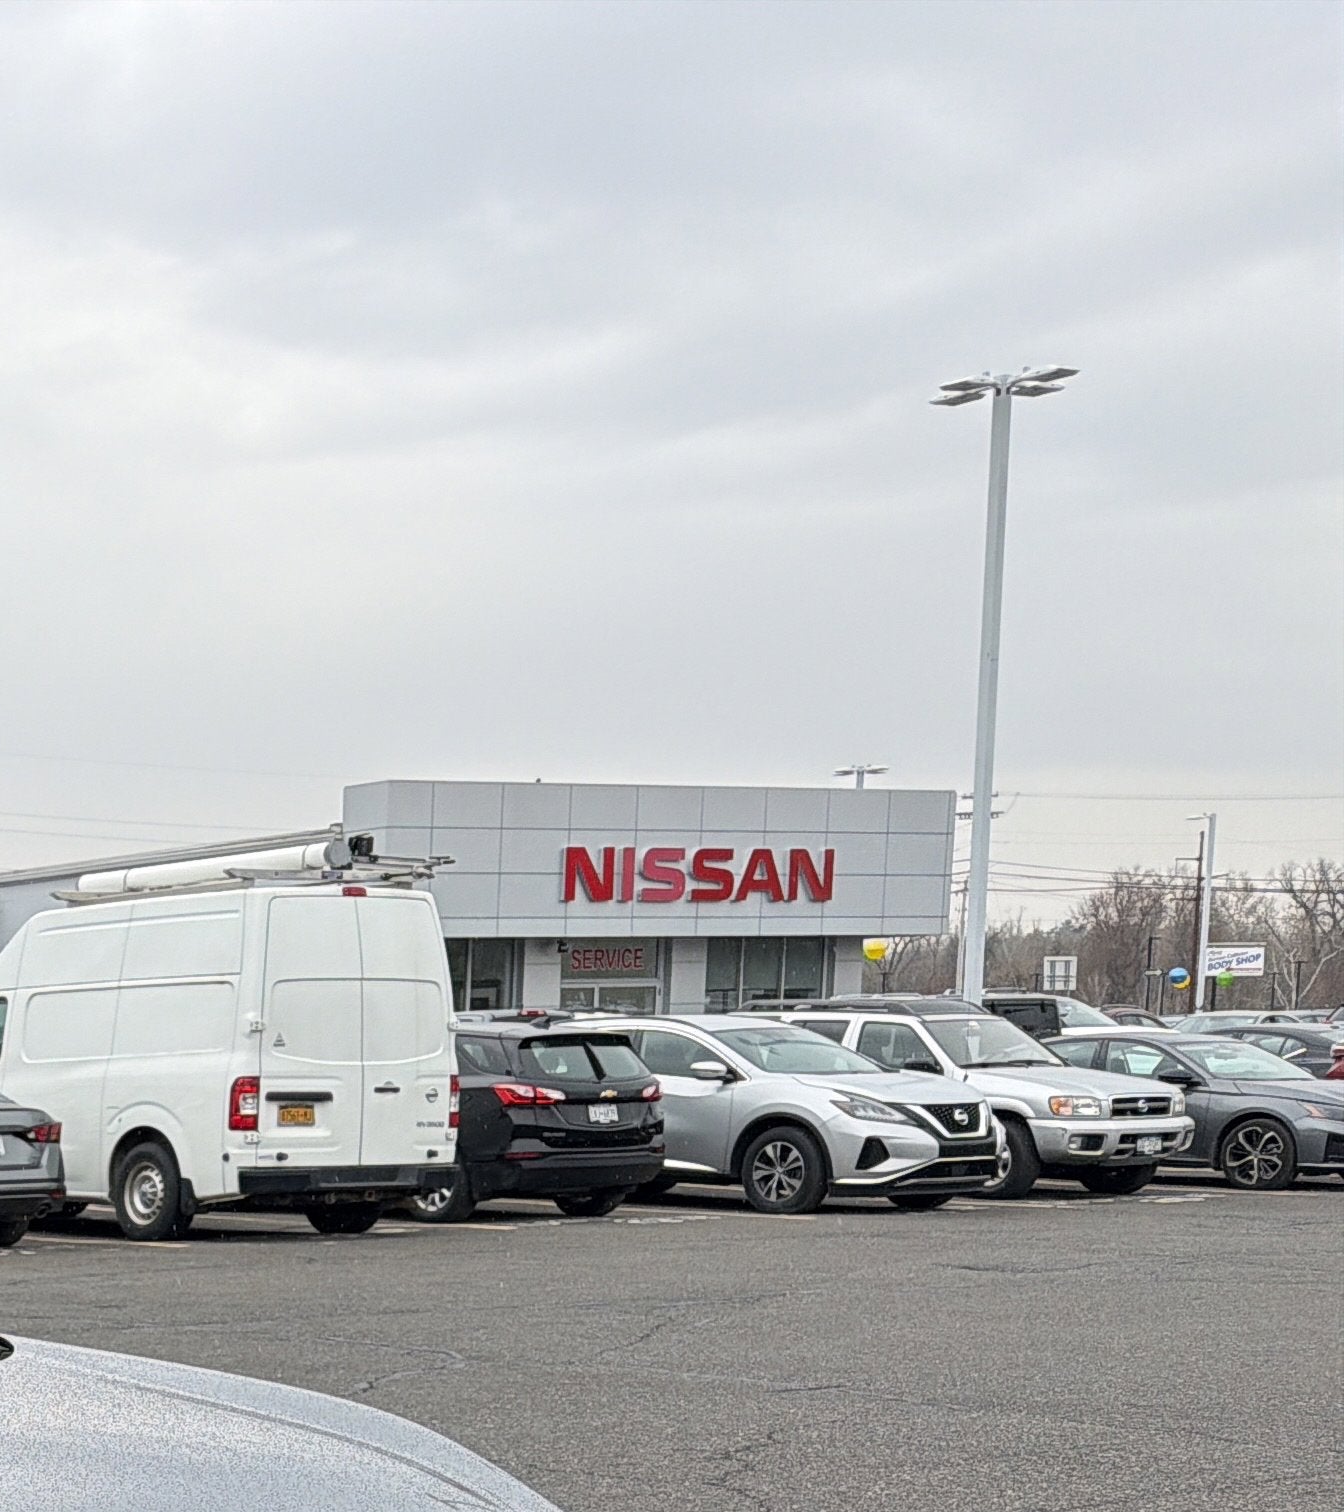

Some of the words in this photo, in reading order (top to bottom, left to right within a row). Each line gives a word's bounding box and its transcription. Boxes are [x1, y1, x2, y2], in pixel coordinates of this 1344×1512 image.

[564, 846, 836, 903] NISSAN
[571, 948, 645, 971] SERVICE
[1208, 959, 1233, 971] BODY
[1236, 953, 1261, 966] SHOP
